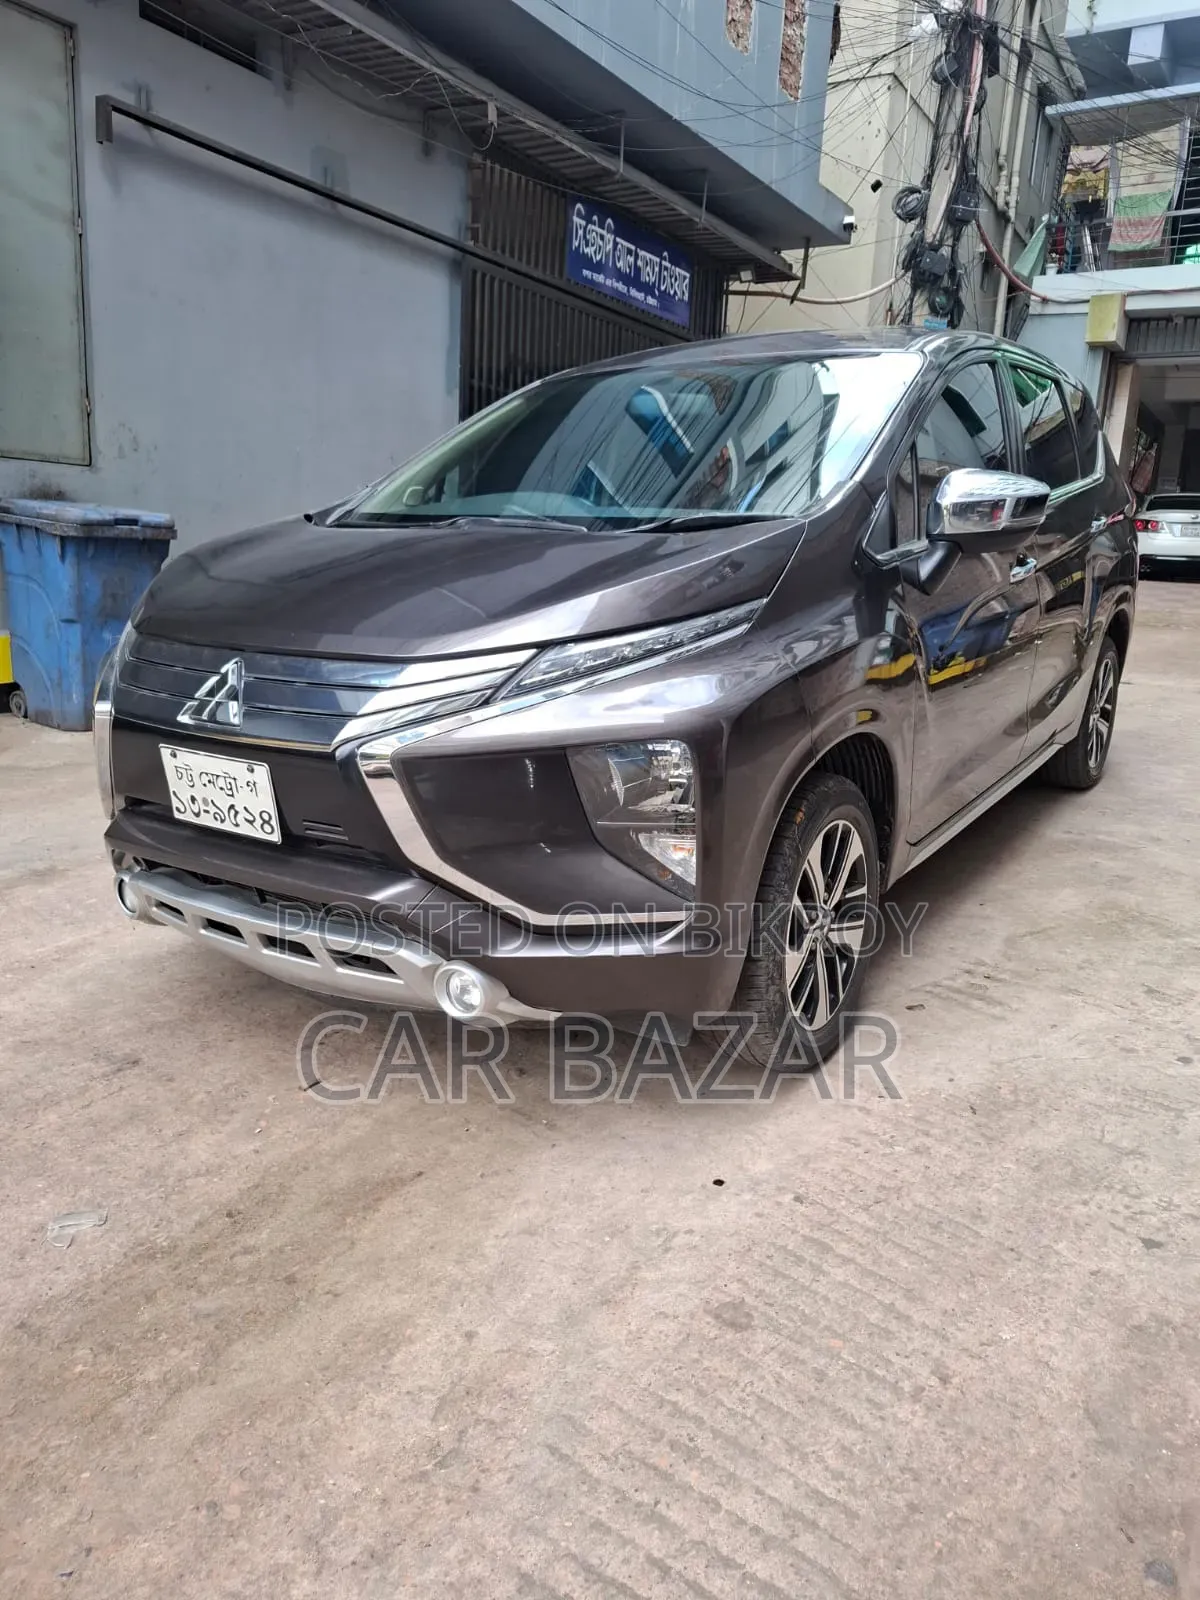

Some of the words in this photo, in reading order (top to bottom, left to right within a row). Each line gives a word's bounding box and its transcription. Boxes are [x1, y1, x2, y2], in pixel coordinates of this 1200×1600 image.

[615, 237, 636, 278] আল
[661, 251, 691, 302] টাওয়ার
[172, 790, 275, 835] ১৩-৯৫২৪
